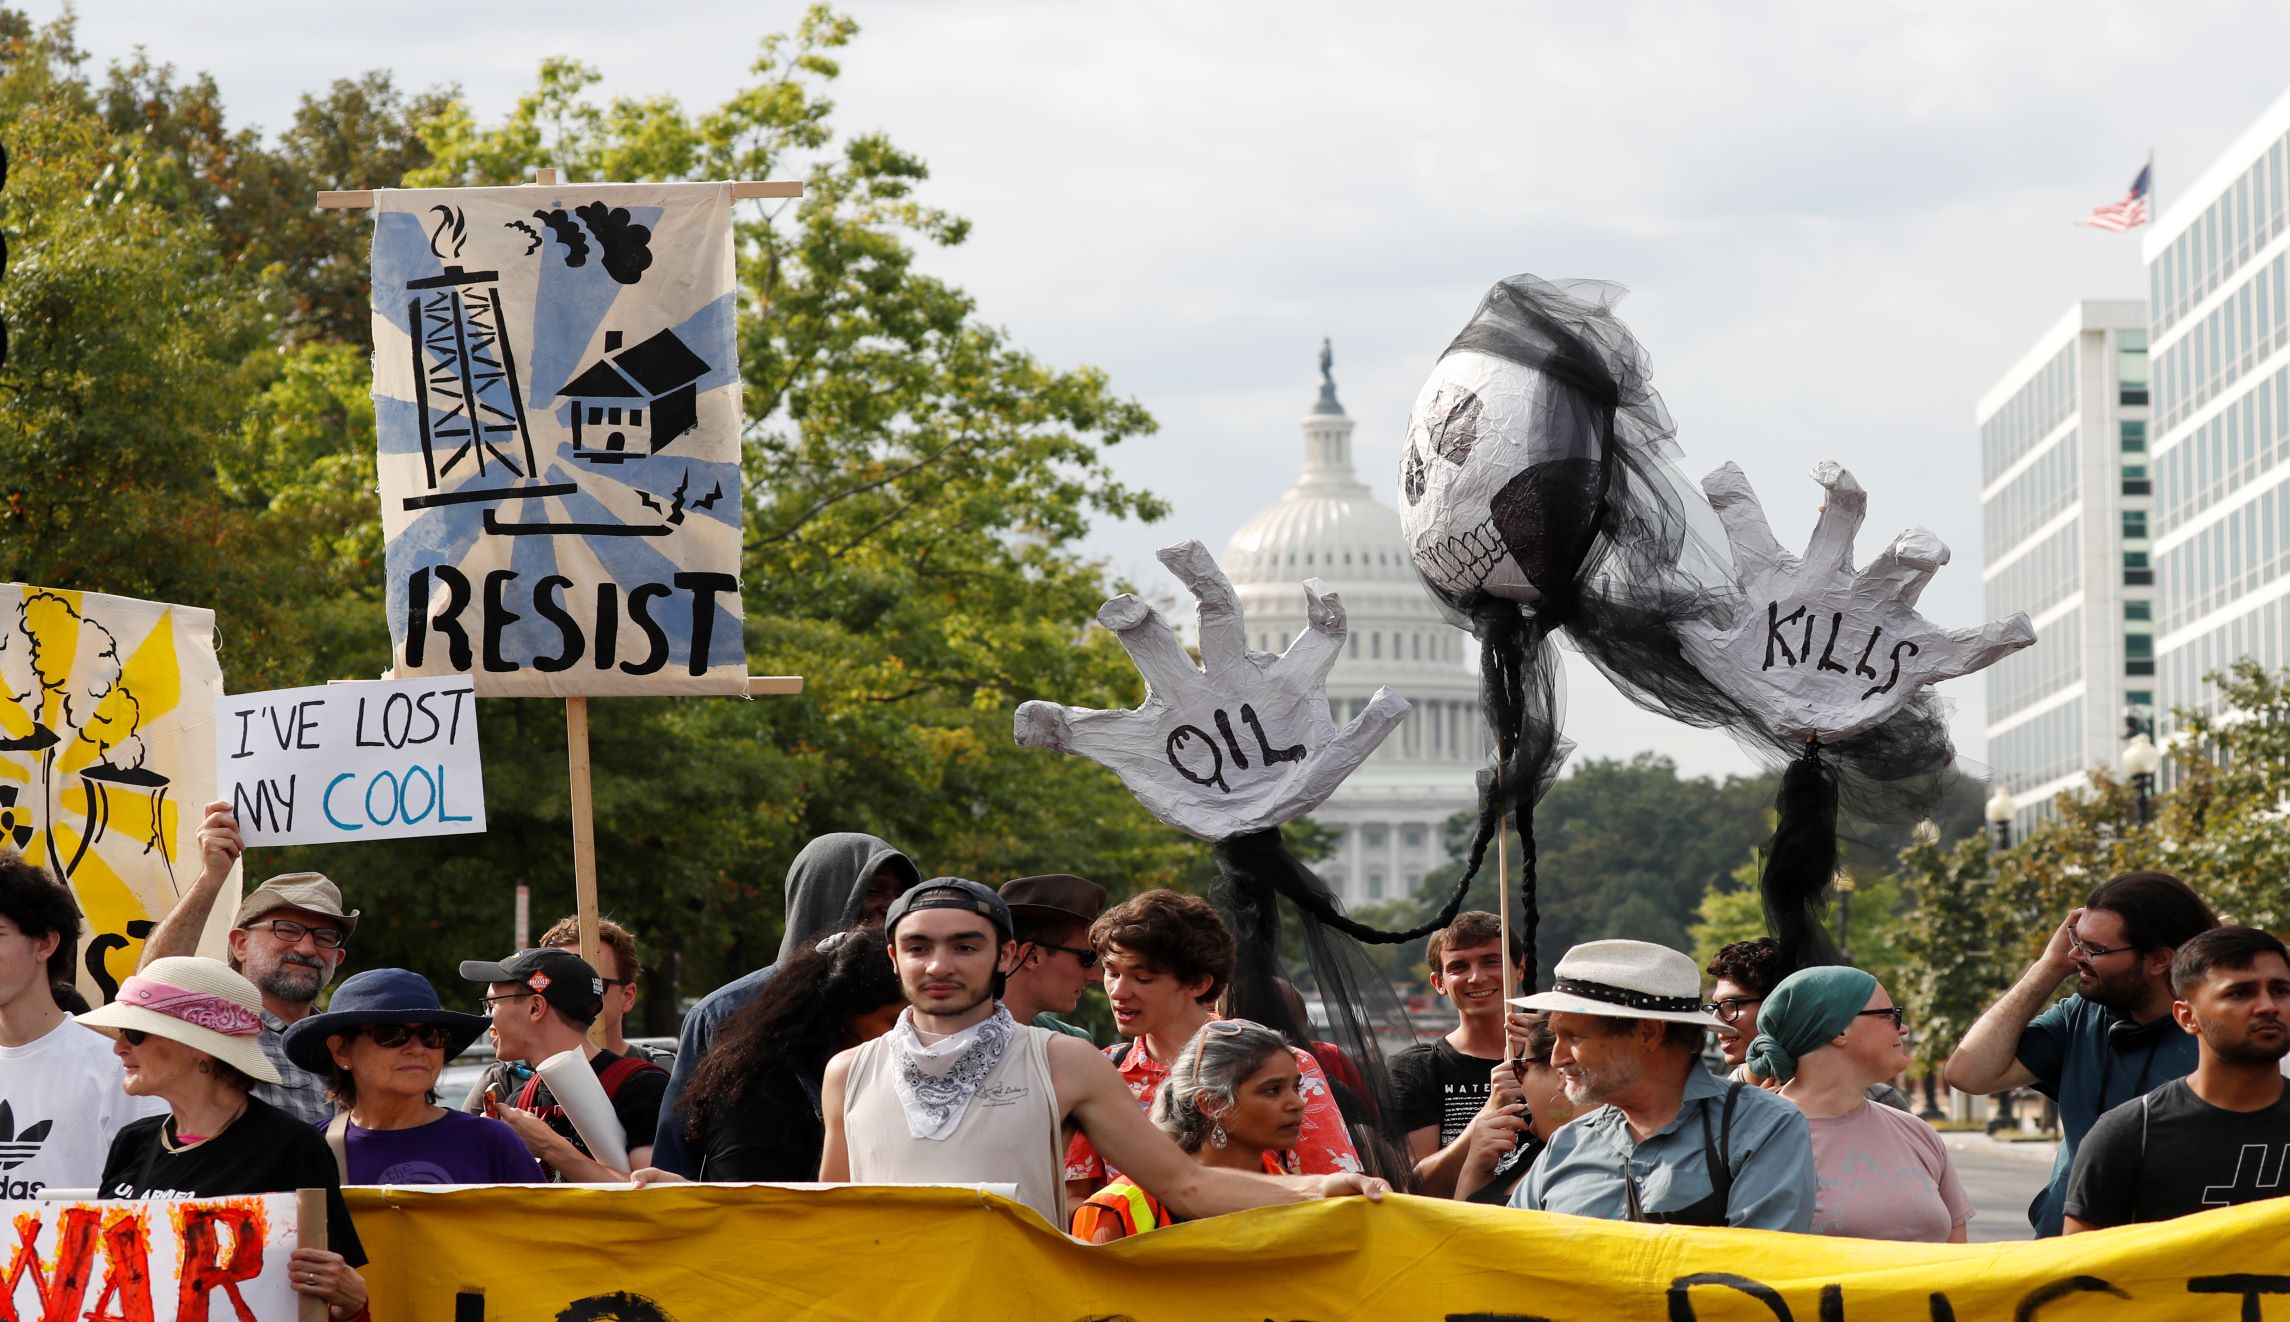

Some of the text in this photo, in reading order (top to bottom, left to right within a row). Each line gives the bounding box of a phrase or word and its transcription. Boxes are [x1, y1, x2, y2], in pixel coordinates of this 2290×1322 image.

[405, 565, 738, 676] RESIST
[1762, 601, 1919, 700] KILLS
[231, 688, 474, 758] I'VE LOST
[233, 764, 473, 833] MY COOL
[1445, 1084, 1490, 1093] WATE
[0, 1175, 46, 1200] das
